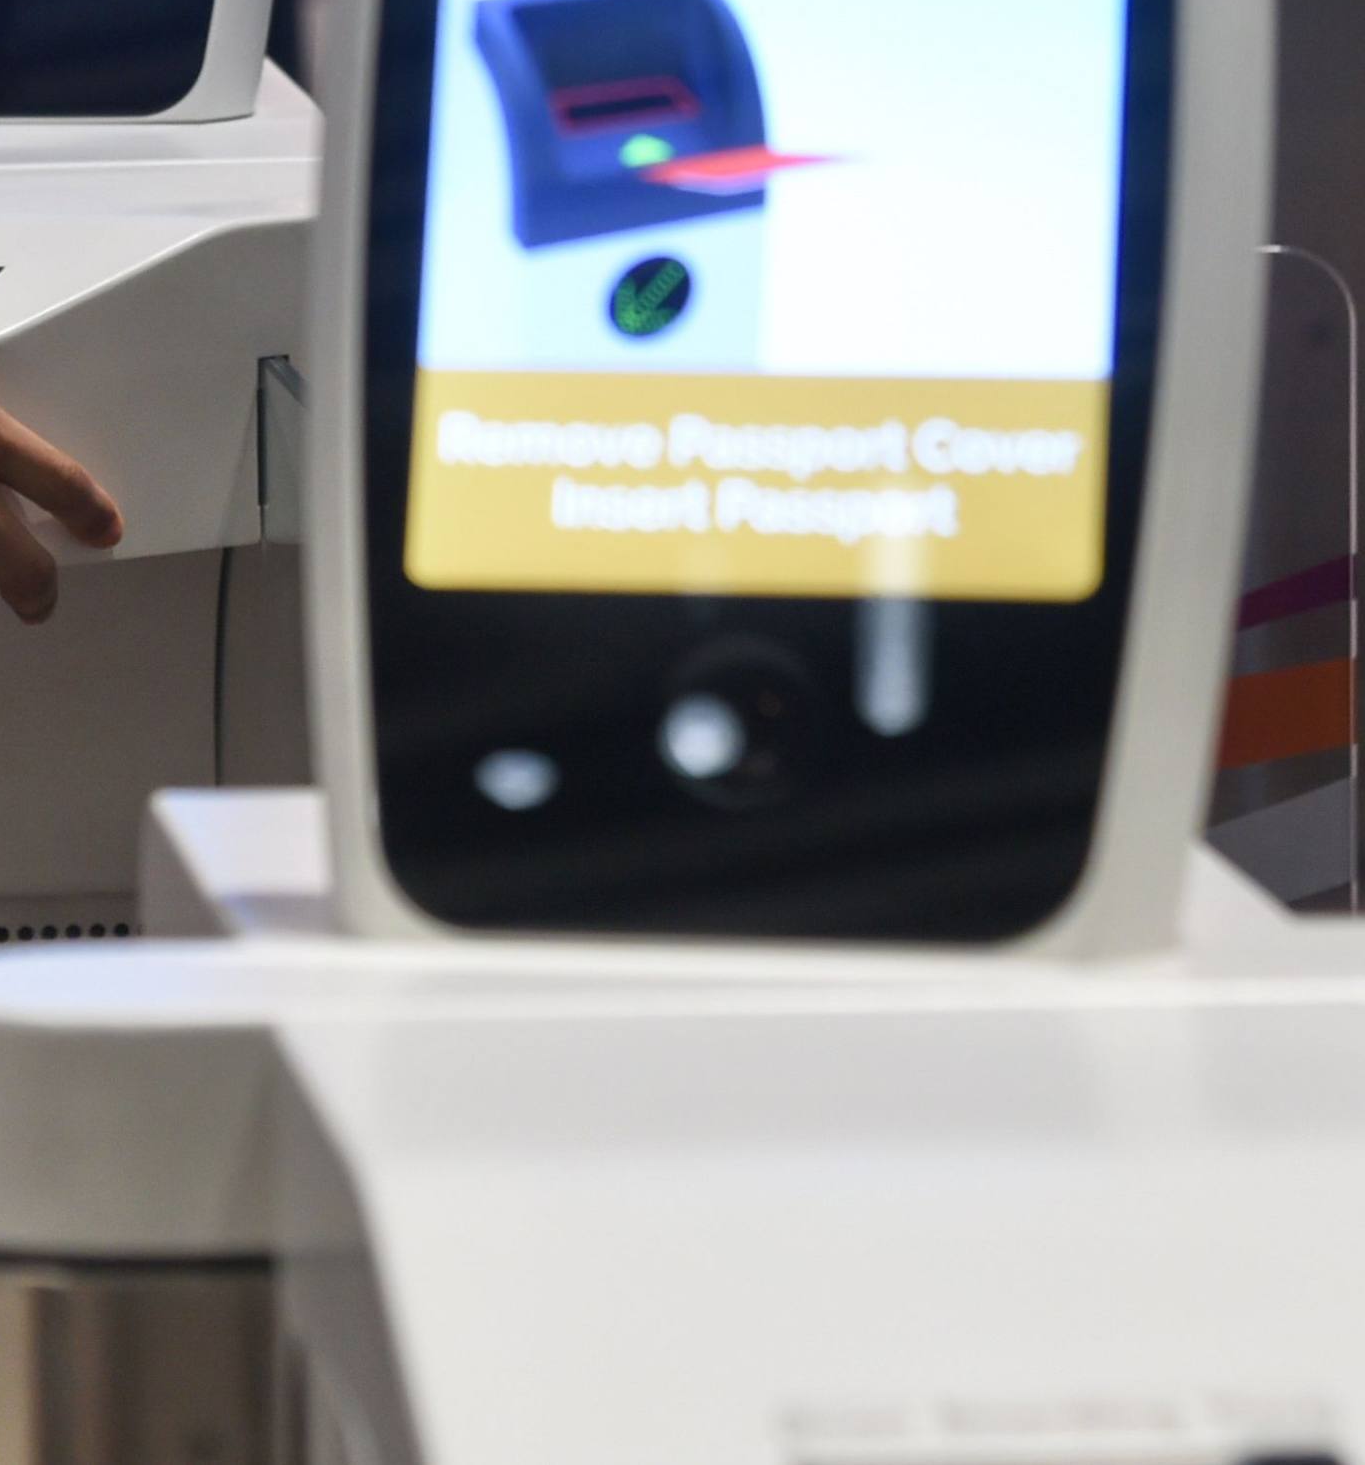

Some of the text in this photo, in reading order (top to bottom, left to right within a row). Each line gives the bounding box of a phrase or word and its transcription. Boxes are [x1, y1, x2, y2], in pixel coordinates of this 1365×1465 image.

[437, 410, 1081, 480] Remove Passport Cover
[551, 476, 959, 545] Insert Passport
